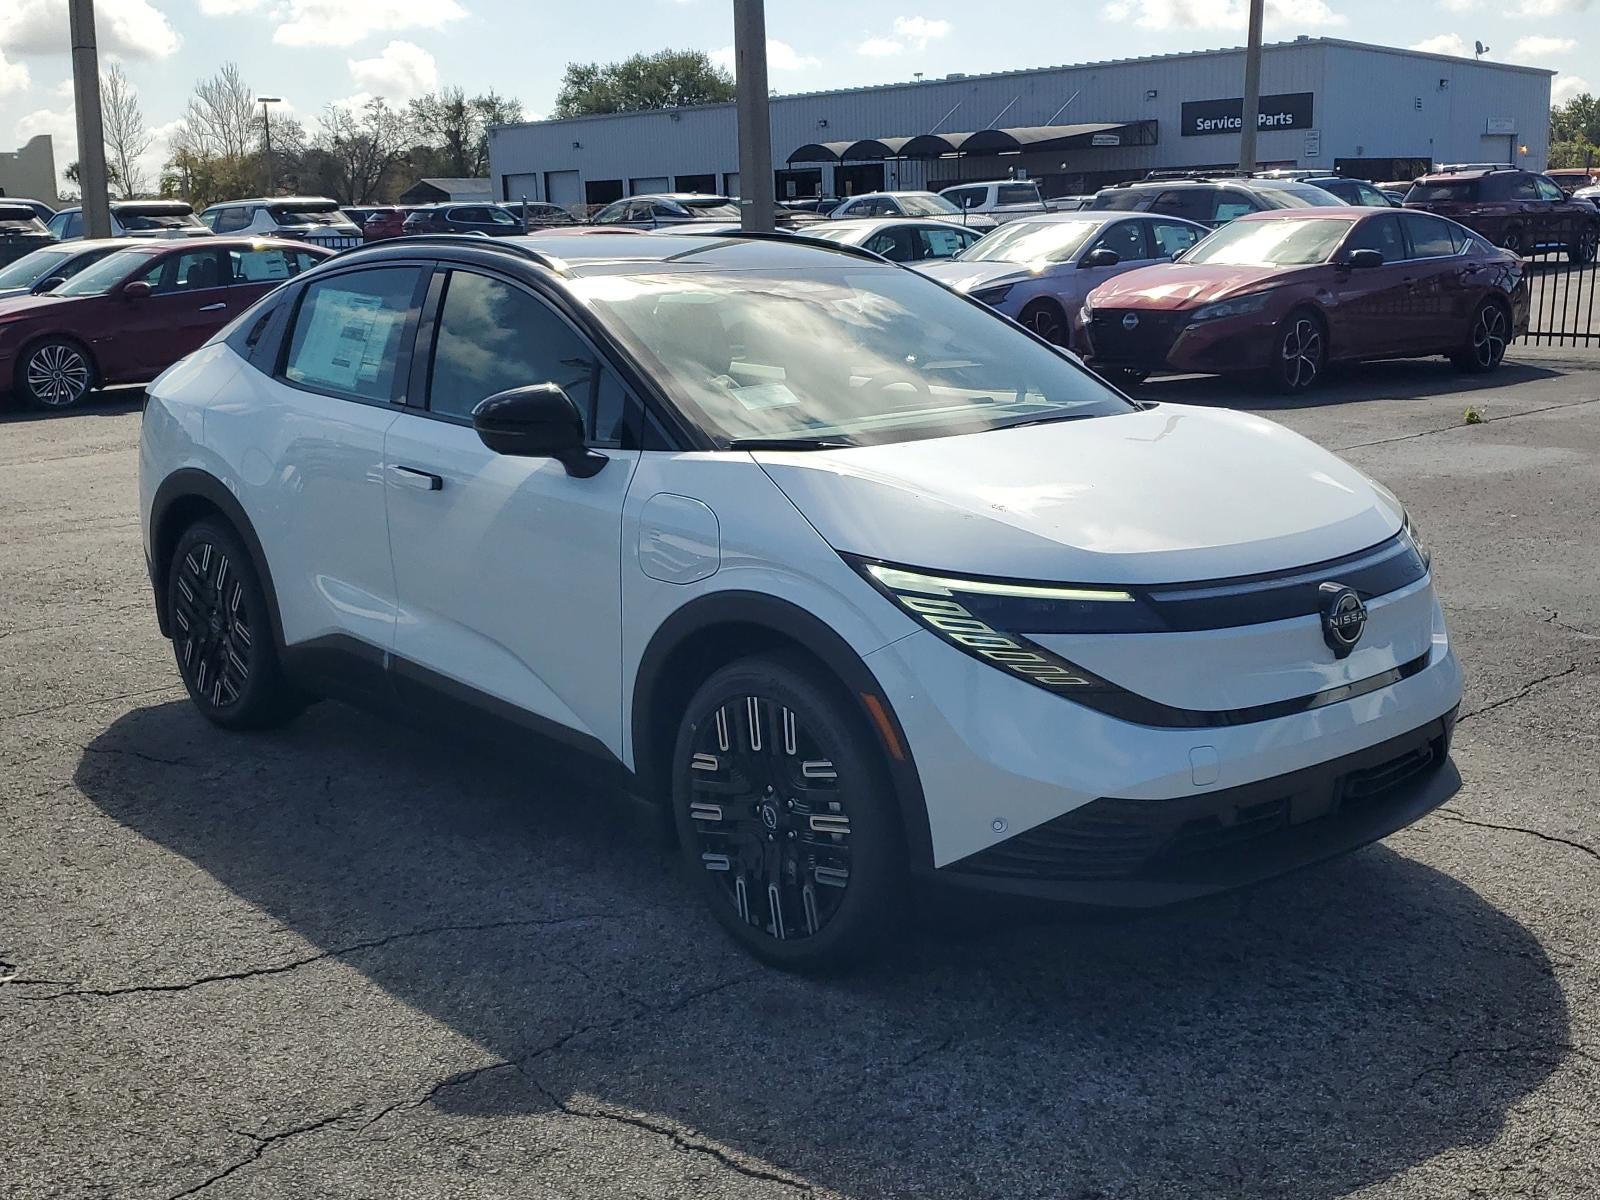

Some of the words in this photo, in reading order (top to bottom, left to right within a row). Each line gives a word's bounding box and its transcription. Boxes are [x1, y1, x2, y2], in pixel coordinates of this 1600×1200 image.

[1196, 116, 1242, 130] Service
[1258, 112, 1293, 126] Parts
[1329, 611, 1367, 627] NISSAN
